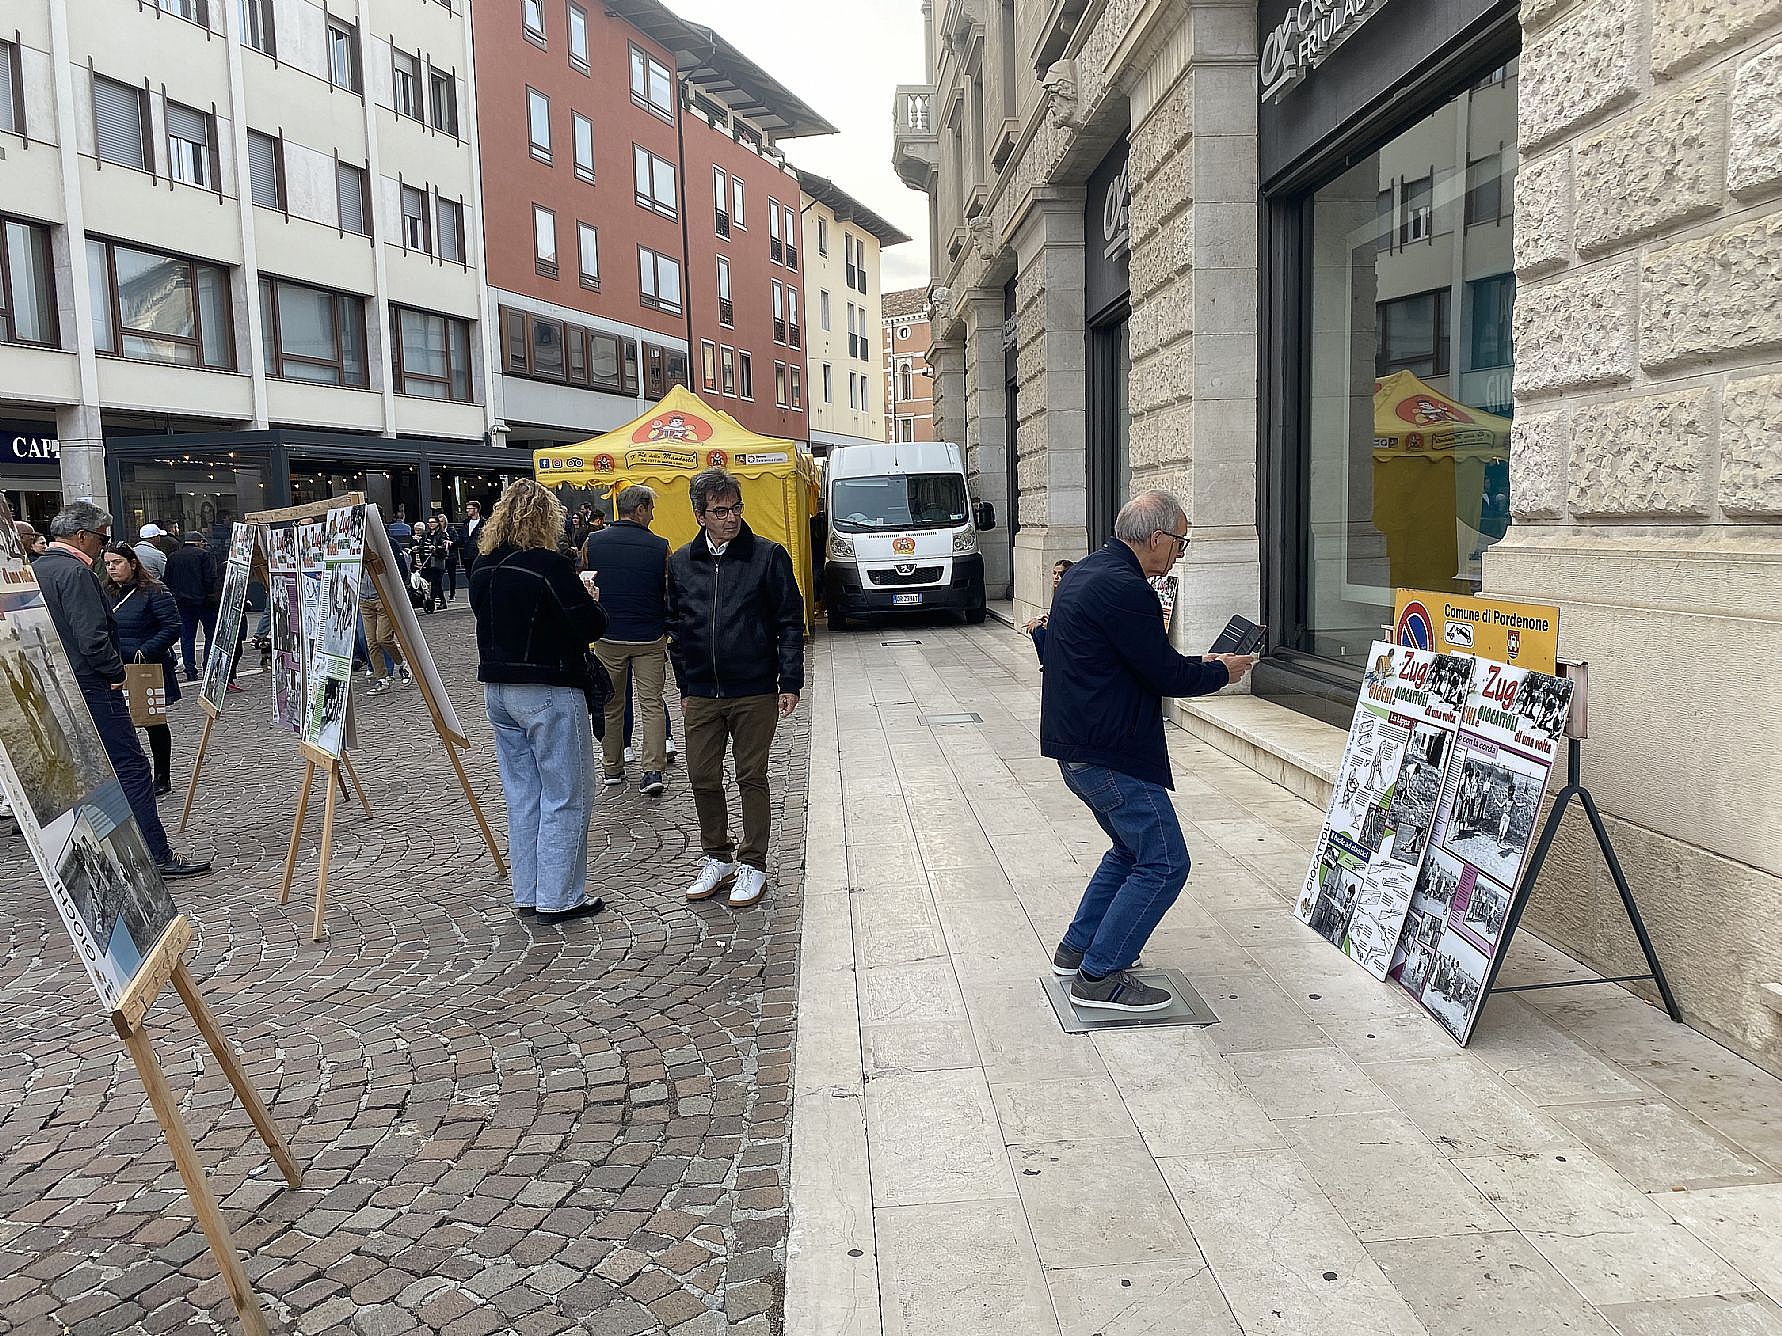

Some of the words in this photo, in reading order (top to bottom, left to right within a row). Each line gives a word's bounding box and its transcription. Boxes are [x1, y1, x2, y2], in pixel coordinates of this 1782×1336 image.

[1444, 603, 1480, 622] Comune
[1482, 608, 1491, 623] di
[1493, 611, 1549, 632] Pordenone
[1399, 650, 1429, 689] Zug
[1368, 684, 1394, 705] GIOCHI
[1394, 685, 1429, 708] GIOCATTOLI
[1482, 664, 1518, 710] Zug
[1442, 711, 1457, 724] volta
[1475, 719, 1480, 728] e
[1478, 705, 1519, 732] GIOCATTOLI
[1463, 736, 1473, 745] con
[1472, 737, 1479, 748] la
[1479, 740, 1496, 754] corda
[1515, 730, 1522, 743] di
[1522, 735, 1534, 748] una
[1535, 738, 1552, 755] volta
[1306, 821, 1331, 891] GIOCATTOLI
[53, 879, 97, 963] GIOCHI
